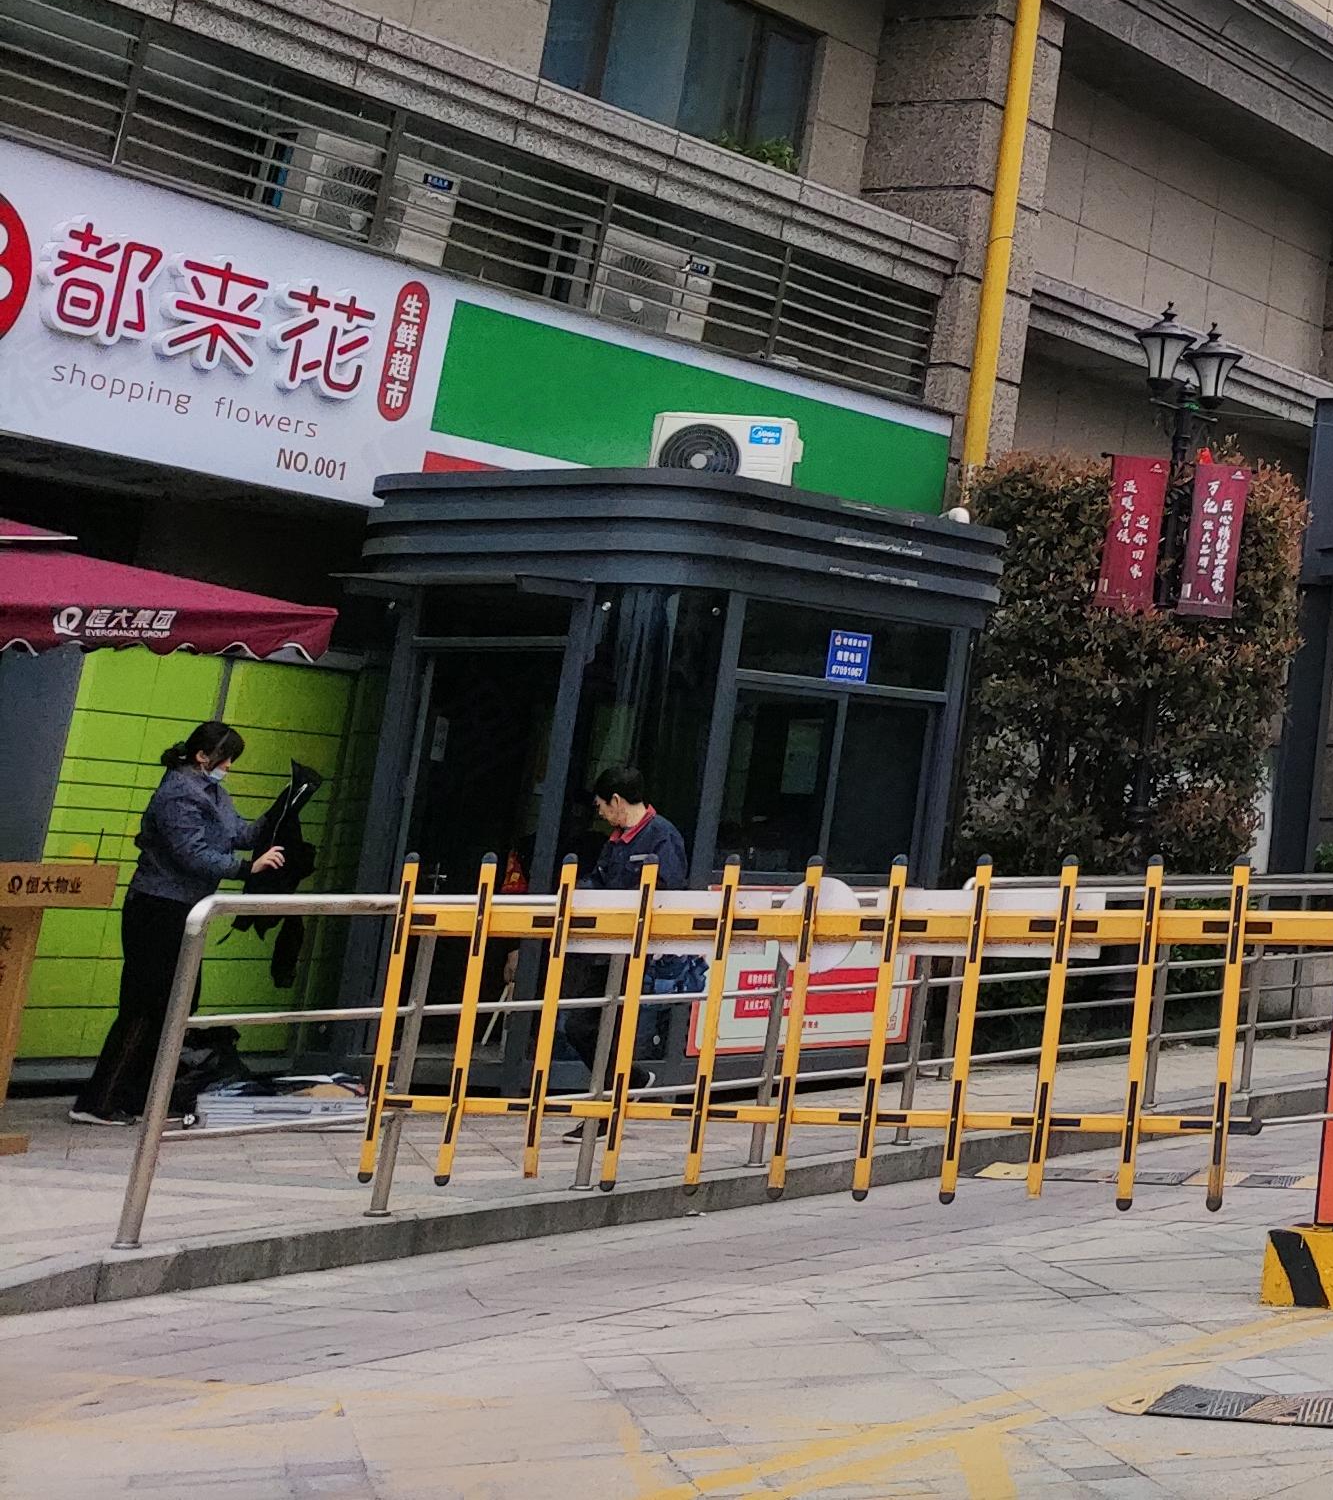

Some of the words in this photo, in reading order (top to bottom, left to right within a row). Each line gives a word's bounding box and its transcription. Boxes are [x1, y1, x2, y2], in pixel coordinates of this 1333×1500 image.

[53, 221, 376, 394] 都来花
[384, 295, 424, 411] 生鲜超市
[51, 362, 193, 415] shopping
[214, 397, 319, 439] flowers
[276, 448, 347, 482] NO.001
[85, 609, 177, 630] 恒大集团
[142, 630, 171, 639] GROUP
[26, 876, 82, 894] 恒大物业
